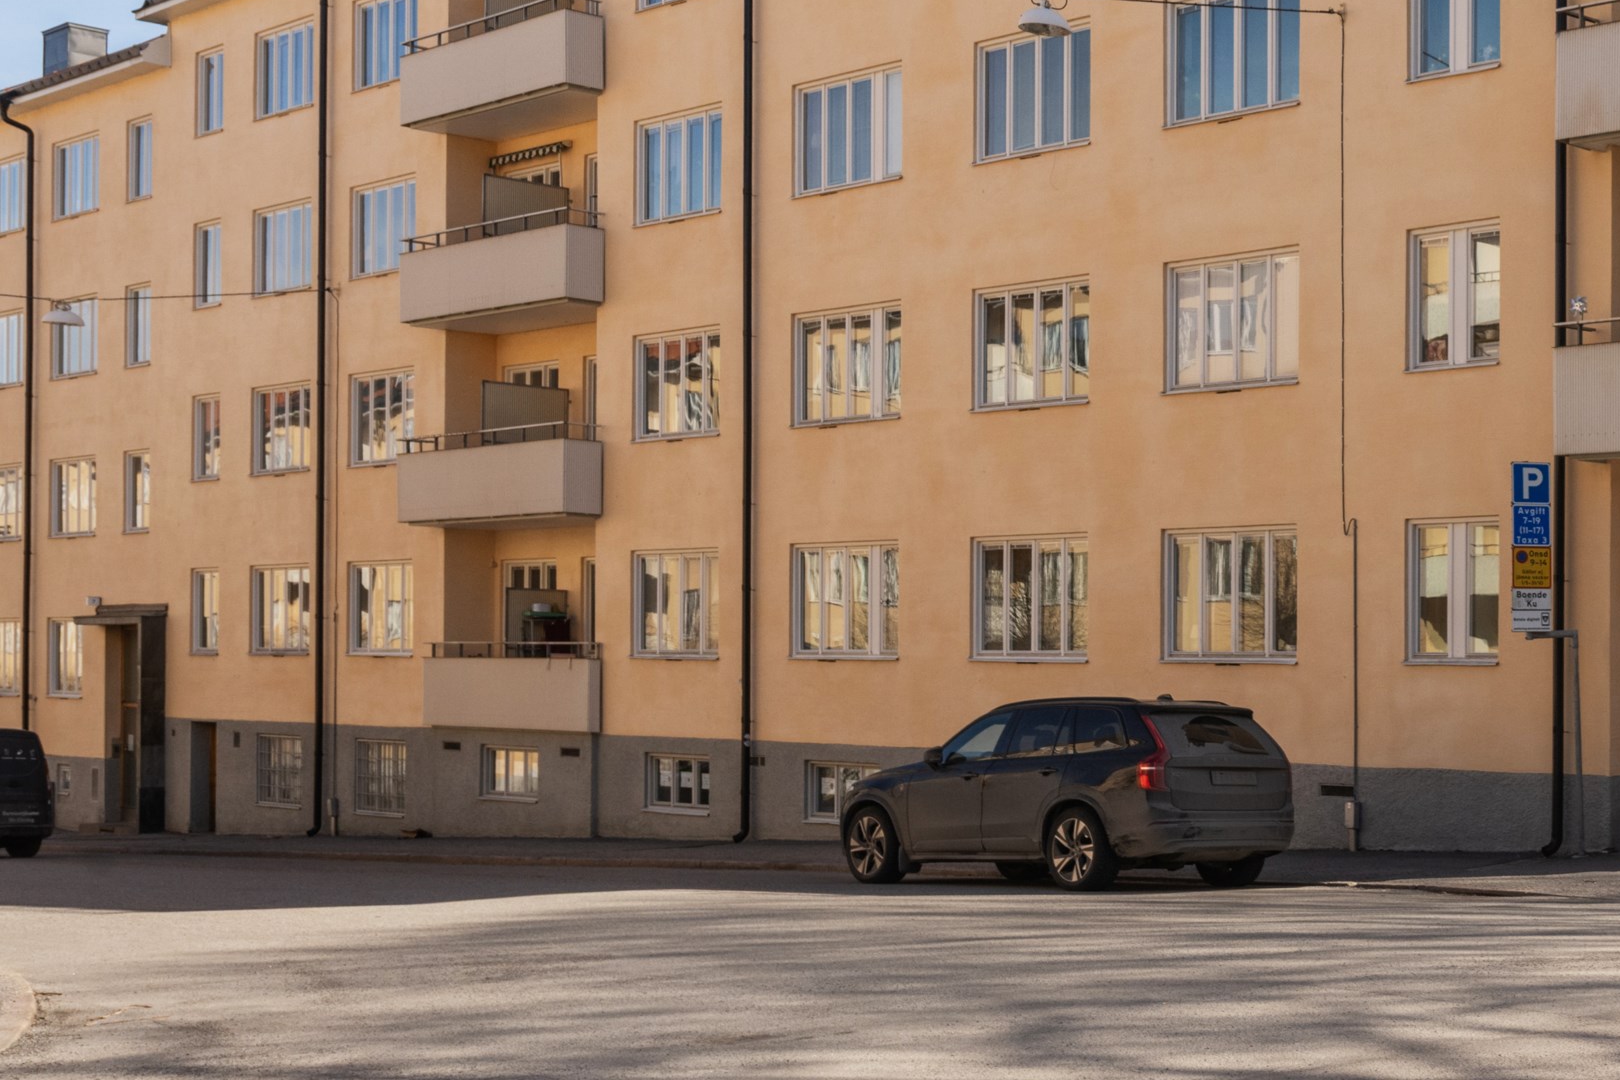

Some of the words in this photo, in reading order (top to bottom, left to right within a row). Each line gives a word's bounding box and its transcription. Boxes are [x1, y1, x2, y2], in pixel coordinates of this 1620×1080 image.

[1522, 467, 1544, 499] P
[1517, 507, 1545, 516] Avgift
[1522, 516, 1541, 524] 7-19
[1516, 536, 1538, 544] Taxa
[1541, 536, 1547, 544] 3
[1529, 550, 1548, 558] Onsd
[1530, 558, 1547, 566] 9-14
[1516, 591, 1547, 599] Boende
[1526, 600, 1538, 608] Ku
